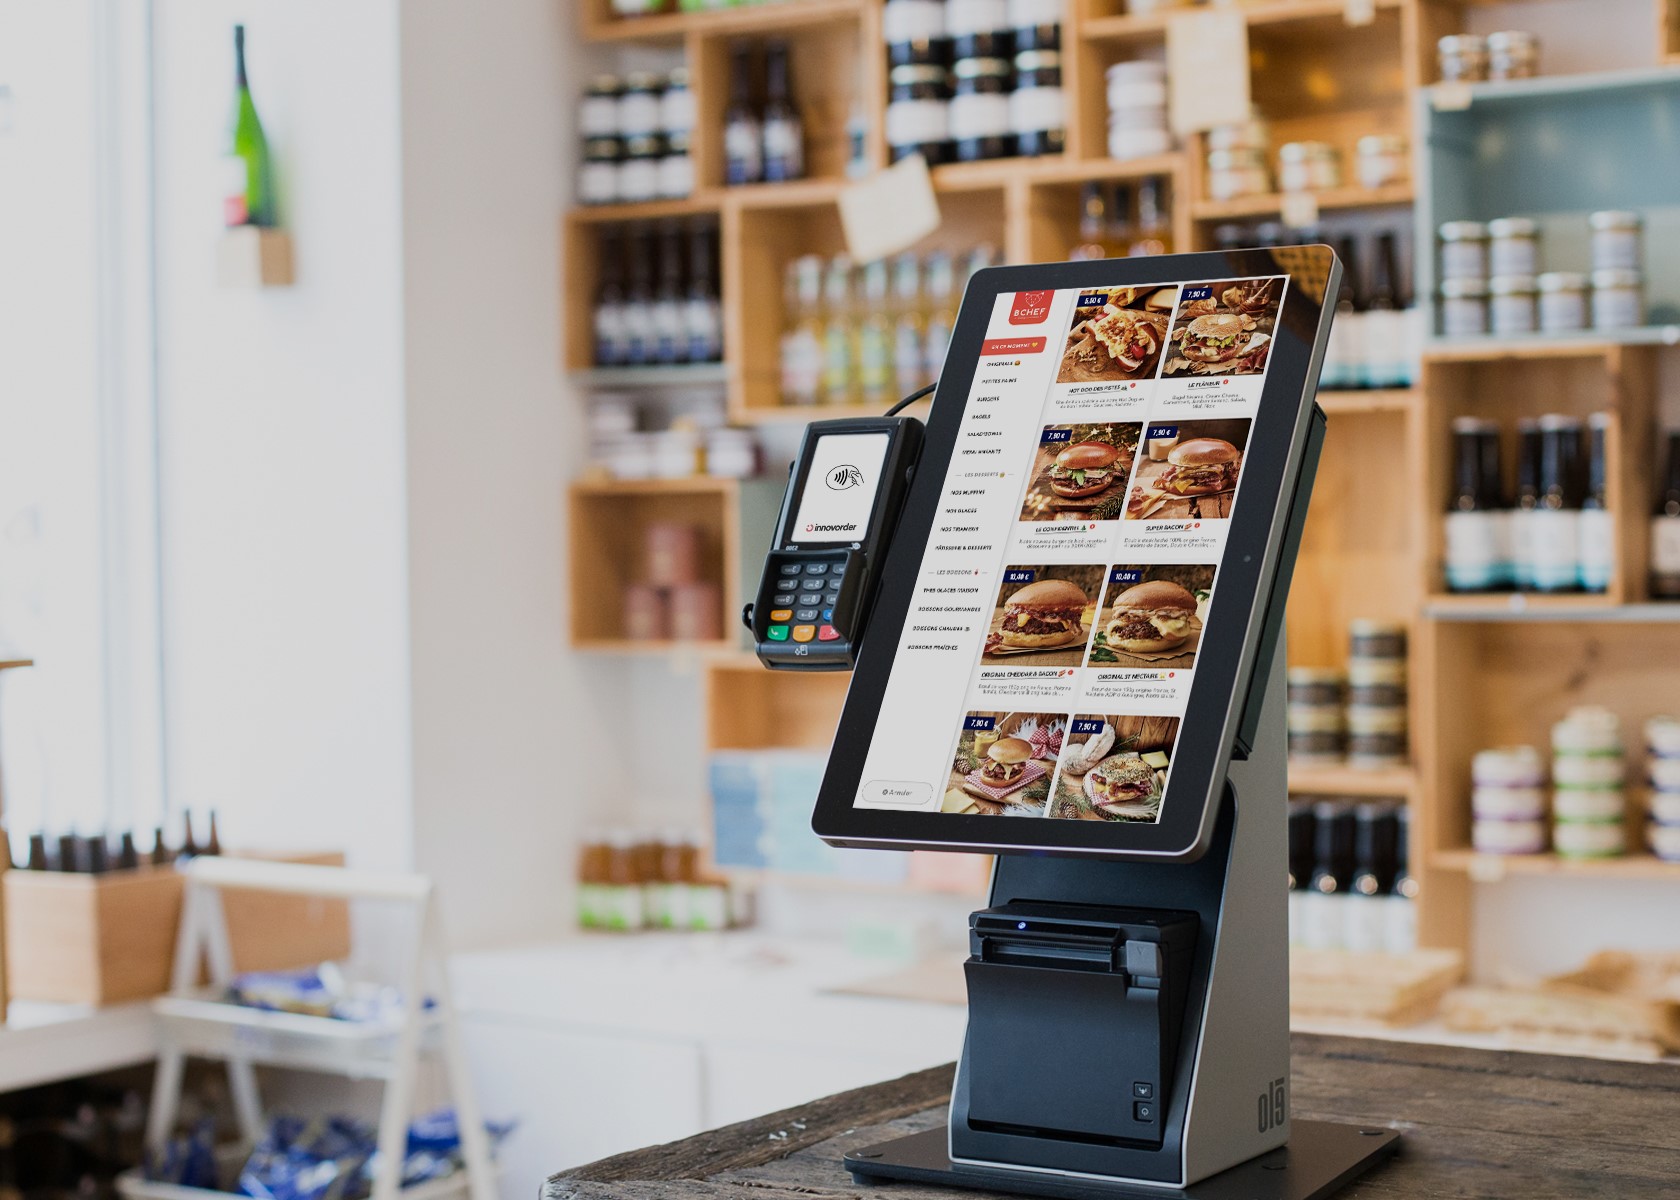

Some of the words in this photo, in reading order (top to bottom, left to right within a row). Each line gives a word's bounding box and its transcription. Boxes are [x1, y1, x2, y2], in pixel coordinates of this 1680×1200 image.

[1187, 290, 1201, 299] 7,90
[1013, 307, 1046, 317] BCHEF
[1047, 432, 1060, 440] 7,90
[1152, 429, 1165, 437] 7,90
[814, 522, 857, 532] innovorder
[970, 719, 984, 727] 7,90
[1078, 722, 1091, 731] 7,90
